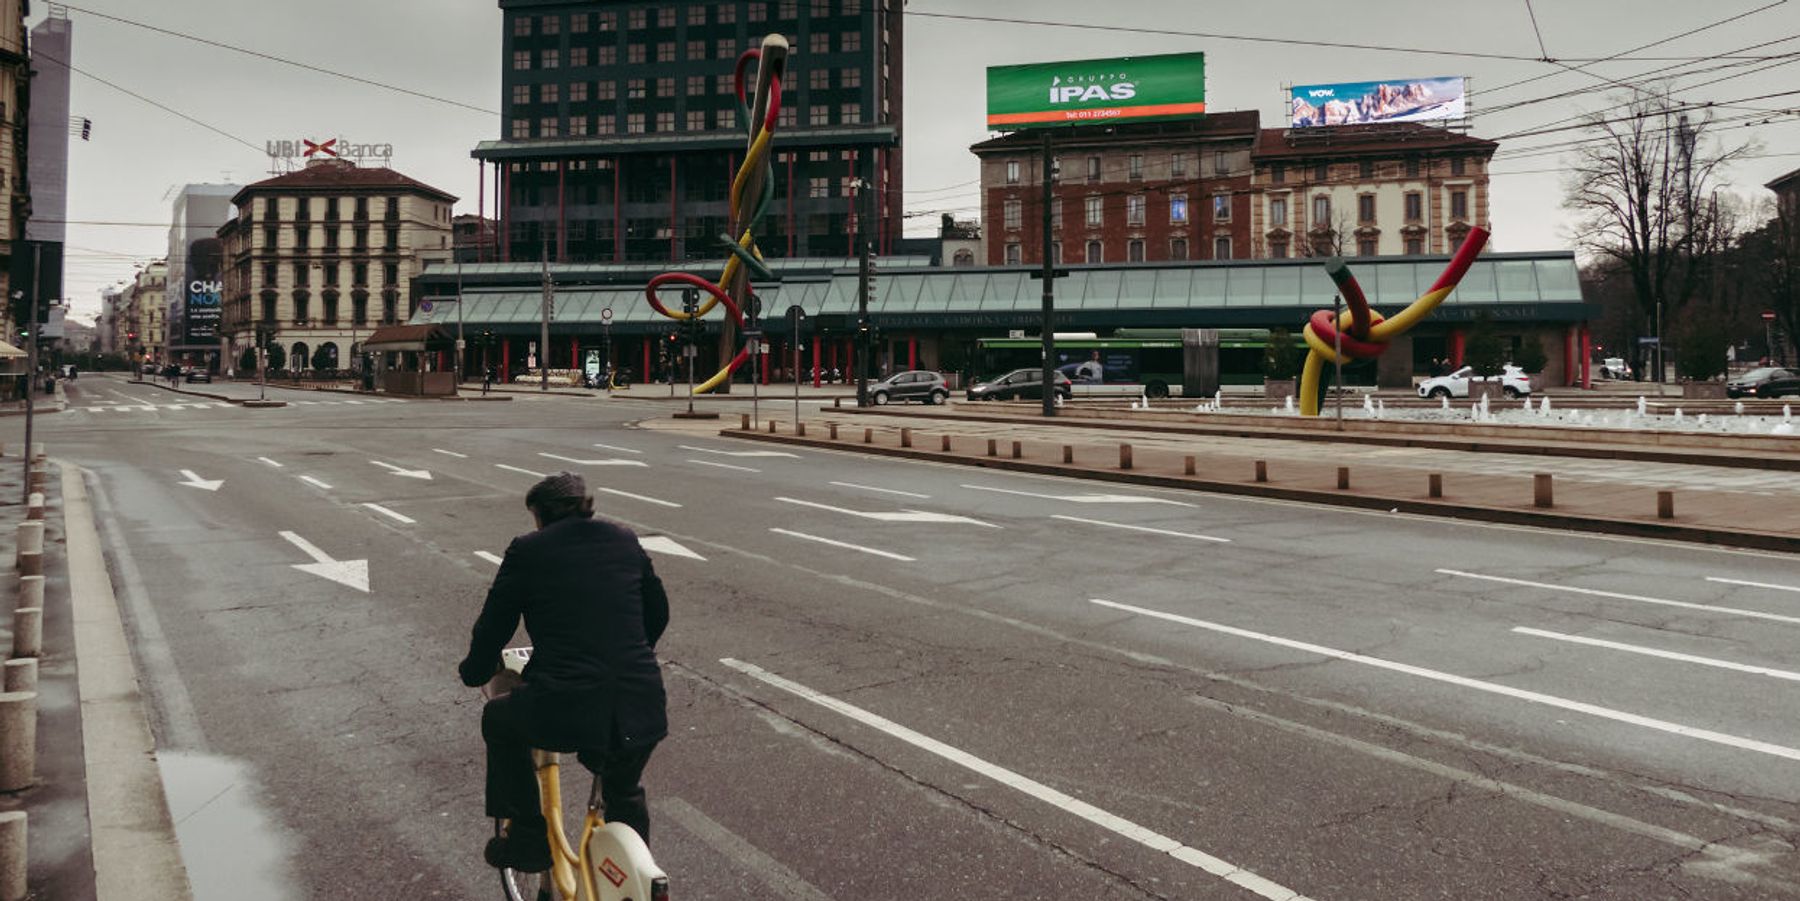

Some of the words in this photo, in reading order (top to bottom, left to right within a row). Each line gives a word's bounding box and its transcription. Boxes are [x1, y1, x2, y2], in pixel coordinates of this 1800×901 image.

[1067, 73, 1126, 83] GRUPPO
[266, 140, 300, 158] UBI
[339, 140, 393, 158] Banca
